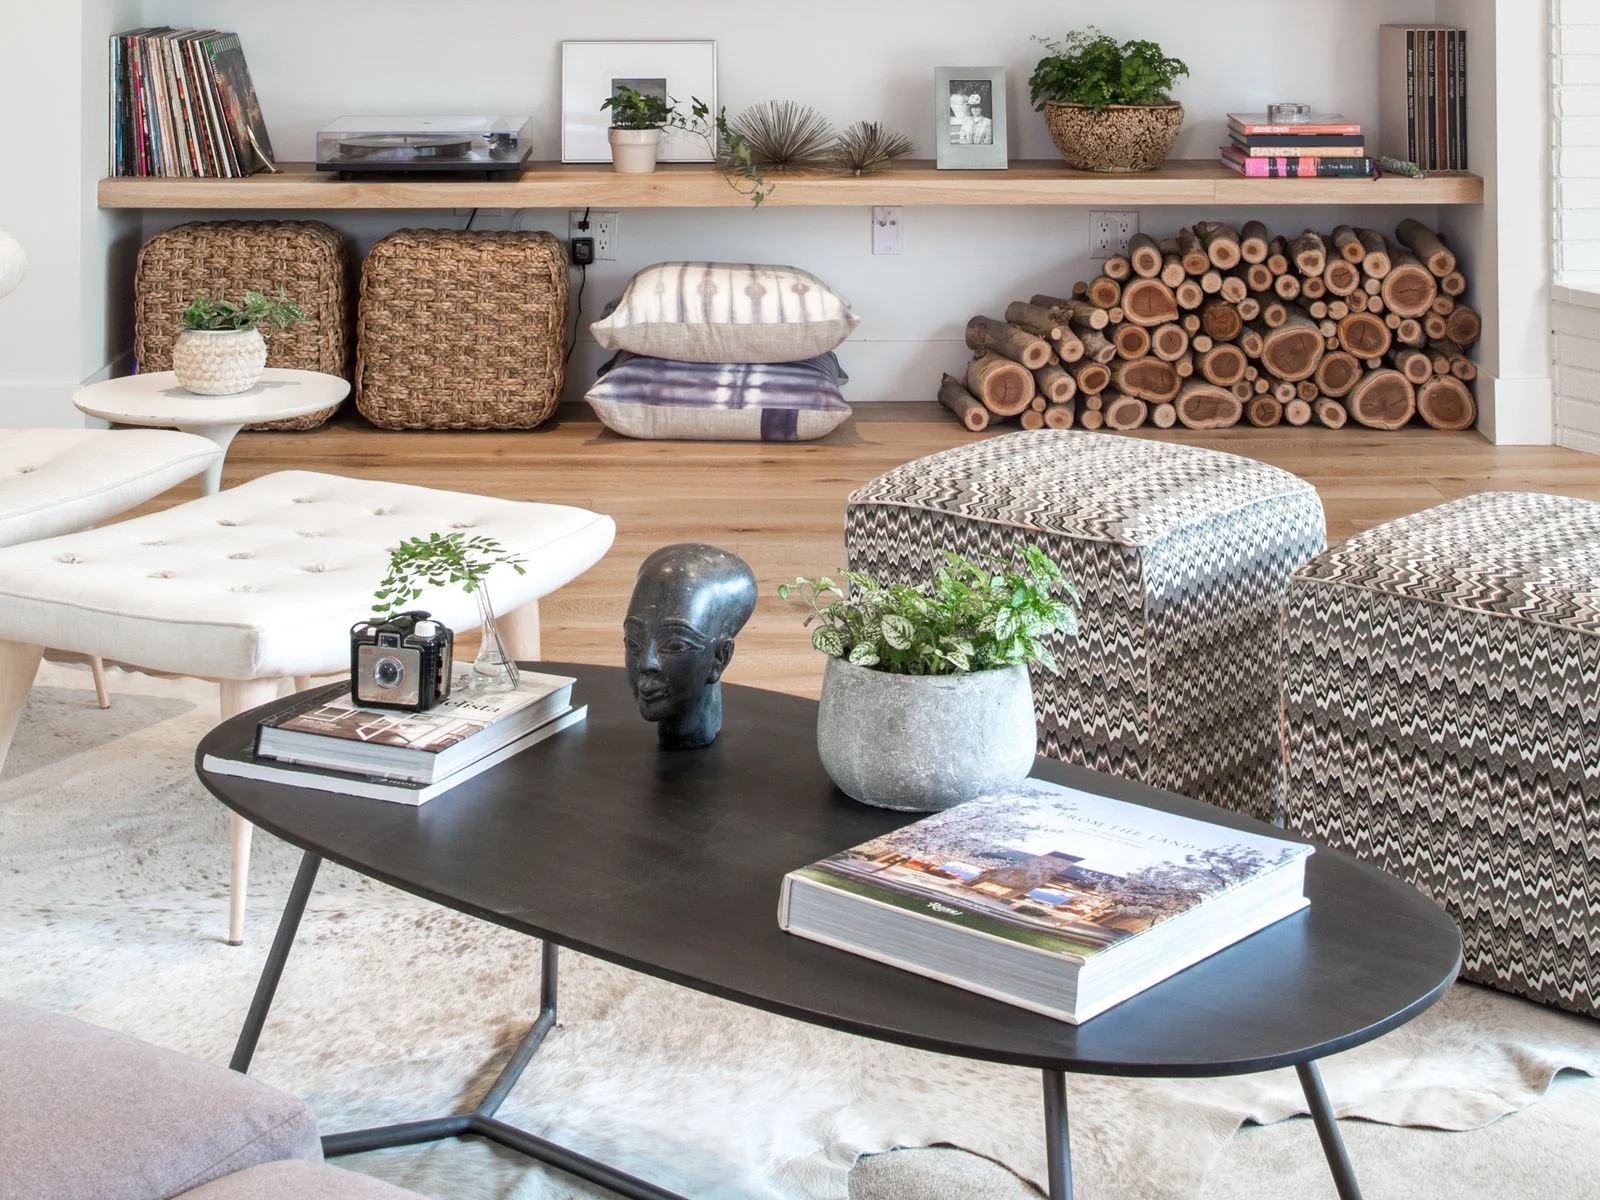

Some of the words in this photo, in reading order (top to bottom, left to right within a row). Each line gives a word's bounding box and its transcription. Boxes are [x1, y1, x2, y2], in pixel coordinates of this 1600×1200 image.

[1057, 812, 1104, 827] FROM
[1109, 825, 1143, 836] THE
[1148, 835, 1196, 849] LAND
